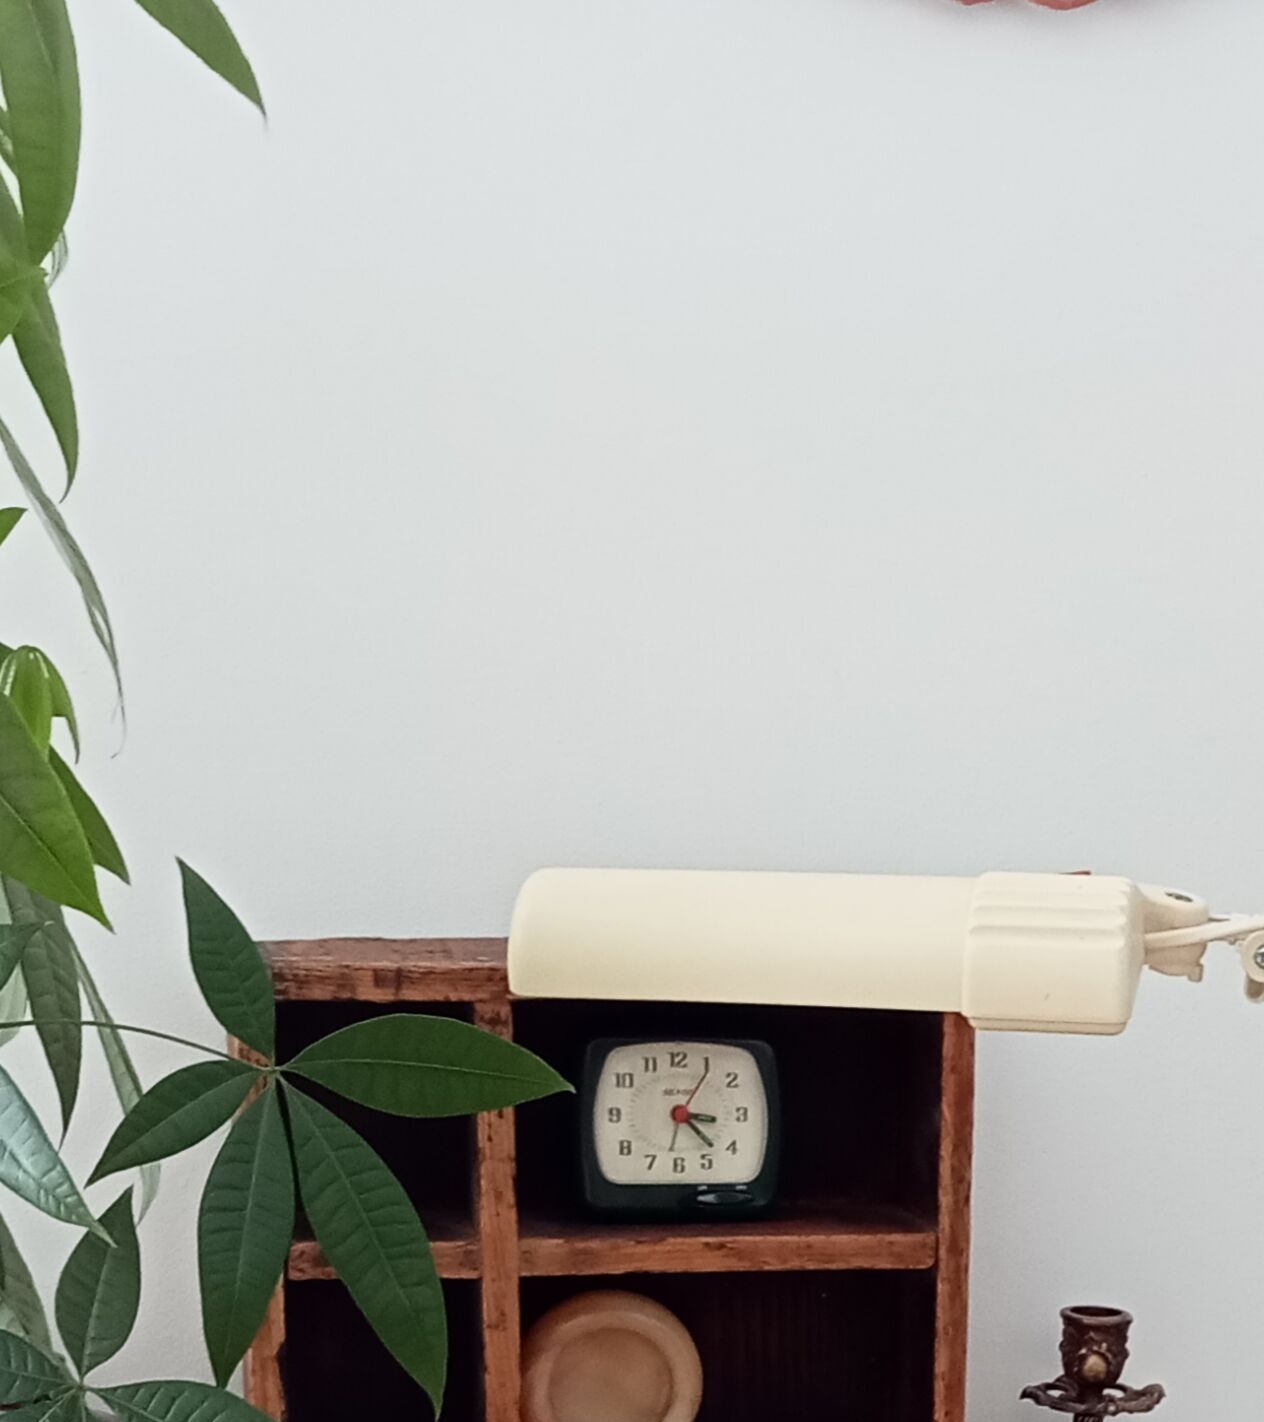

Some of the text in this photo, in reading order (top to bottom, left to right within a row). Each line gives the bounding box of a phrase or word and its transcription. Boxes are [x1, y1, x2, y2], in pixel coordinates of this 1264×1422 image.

[643, 1056, 657, 1073] 11
[668, 1052, 688, 1068] 12
[614, 1073, 634, 1088] 10
[726, 1072, 740, 1088] 2
[608, 1107, 621, 1123] 9
[735, 1107, 748, 1122] 3
[619, 1140, 632, 1156] 8
[726, 1140, 738, 1155] 4
[644, 1155, 657, 1170] 7
[673, 1157, 685, 1173] 6
[701, 1154, 713, 1170] 5
